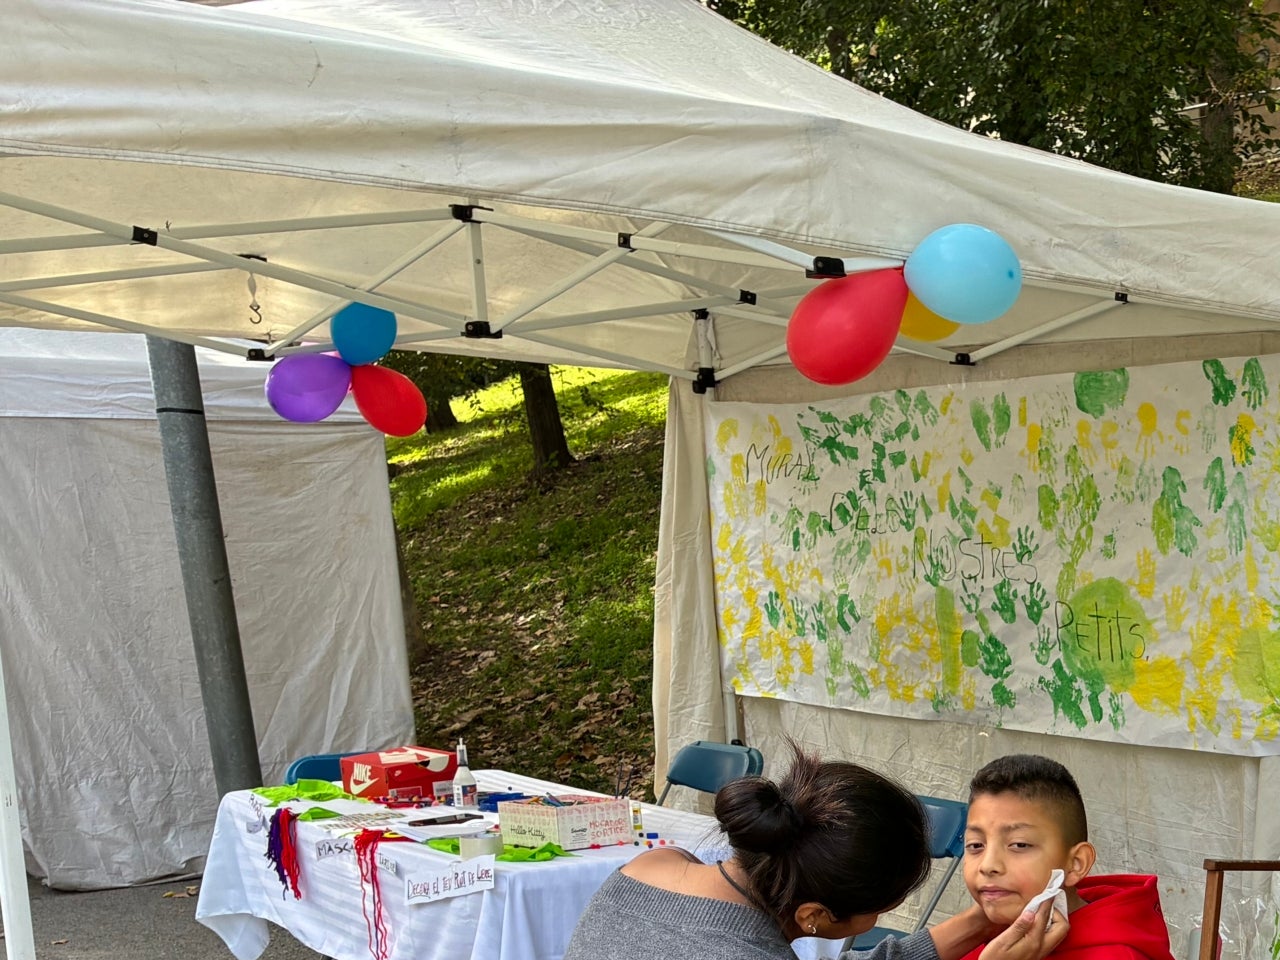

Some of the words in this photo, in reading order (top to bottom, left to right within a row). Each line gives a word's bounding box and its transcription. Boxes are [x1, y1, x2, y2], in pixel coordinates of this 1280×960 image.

[745, 443, 820, 486] MURAL
[353, 762, 372, 782] NIKE
[510, 825, 527, 835] Hello
[528, 826, 546, 839] Kitty
[317, 841, 353, 857] MÀSC
